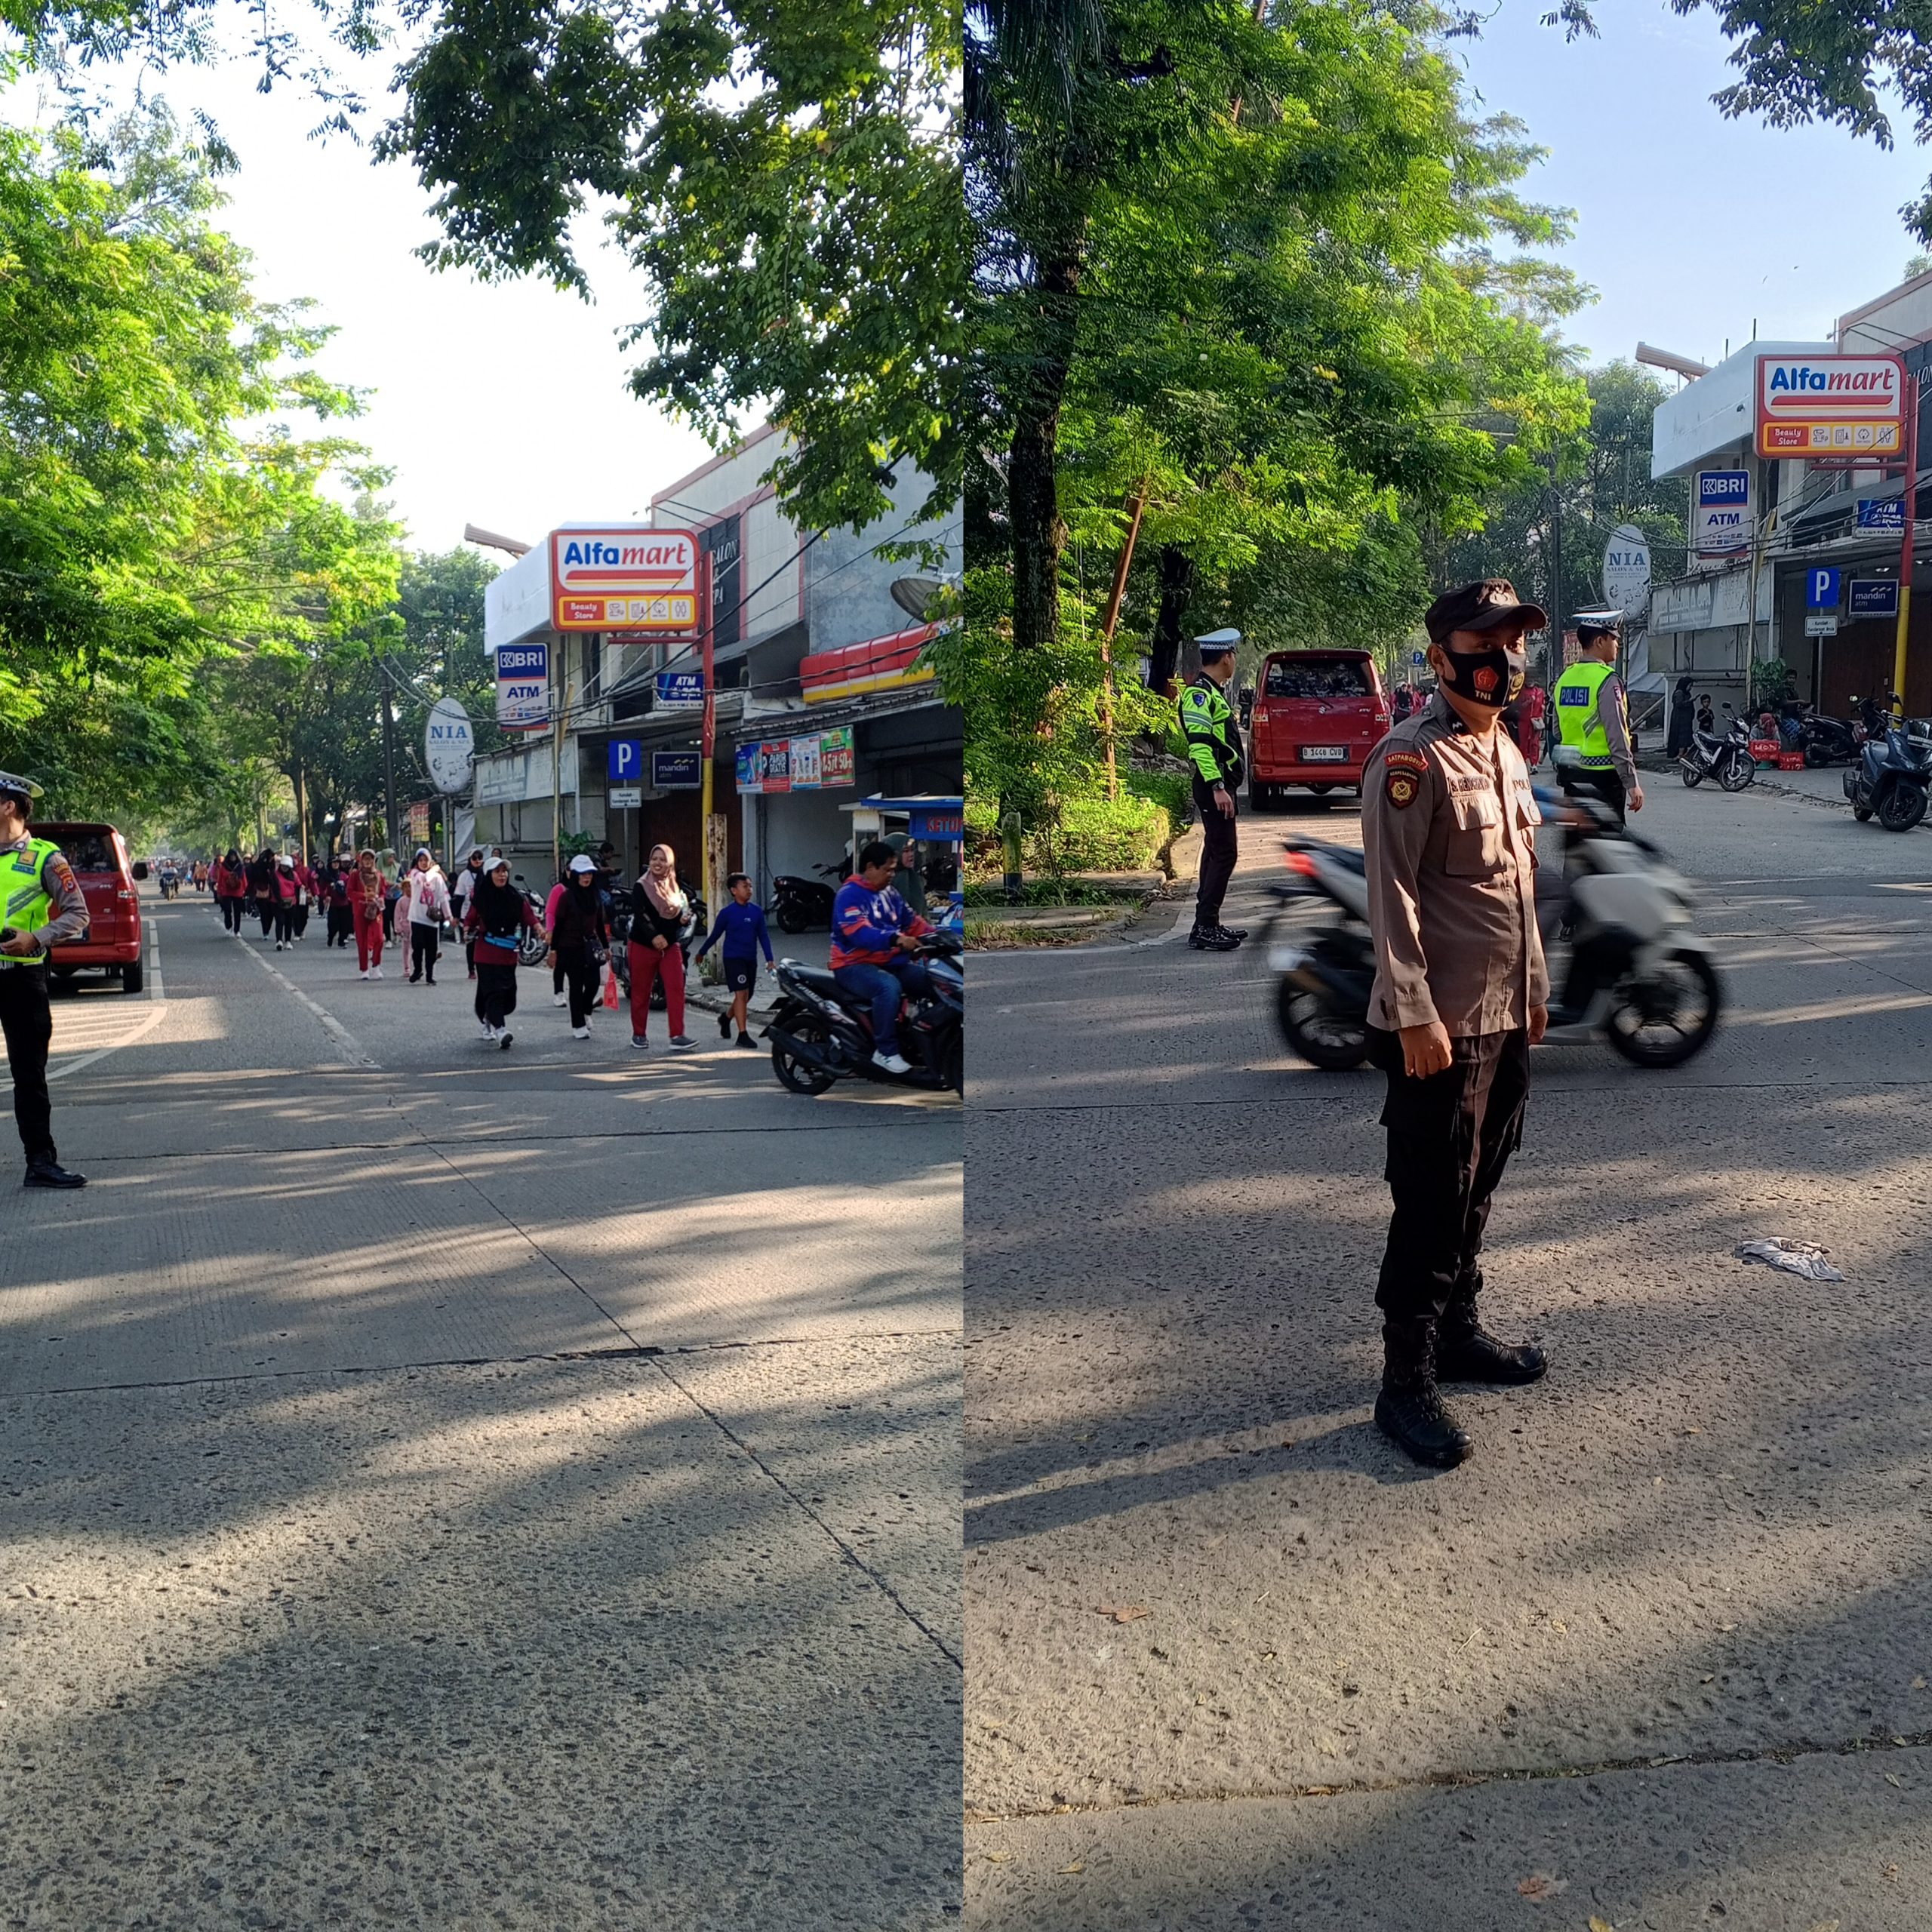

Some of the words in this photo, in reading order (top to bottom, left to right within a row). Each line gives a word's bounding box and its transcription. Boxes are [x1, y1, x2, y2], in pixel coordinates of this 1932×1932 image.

[1770, 367, 1894, 390] Alfamart
[1774, 427, 1801, 438] Beauty
[1777, 437, 1798, 445] Store
[1717, 478, 1745, 494] BRI
[1706, 513, 1740, 525] ATM
[565, 542, 688, 565] Alfamart
[1608, 552, 1646, 566] NIA
[1815, 571, 1829, 601] P
[571, 602, 597, 611] Beauty
[515, 652, 543, 666] BRI
[1415, 653, 1420, 663] P
[676, 676, 696, 686] ATM
[506, 686, 539, 698] ATM
[1475, 690, 1491, 701] TNI
[1561, 689, 1587, 703] POLISI
[430, 725, 468, 738] NIA
[617, 743, 632, 774] P
